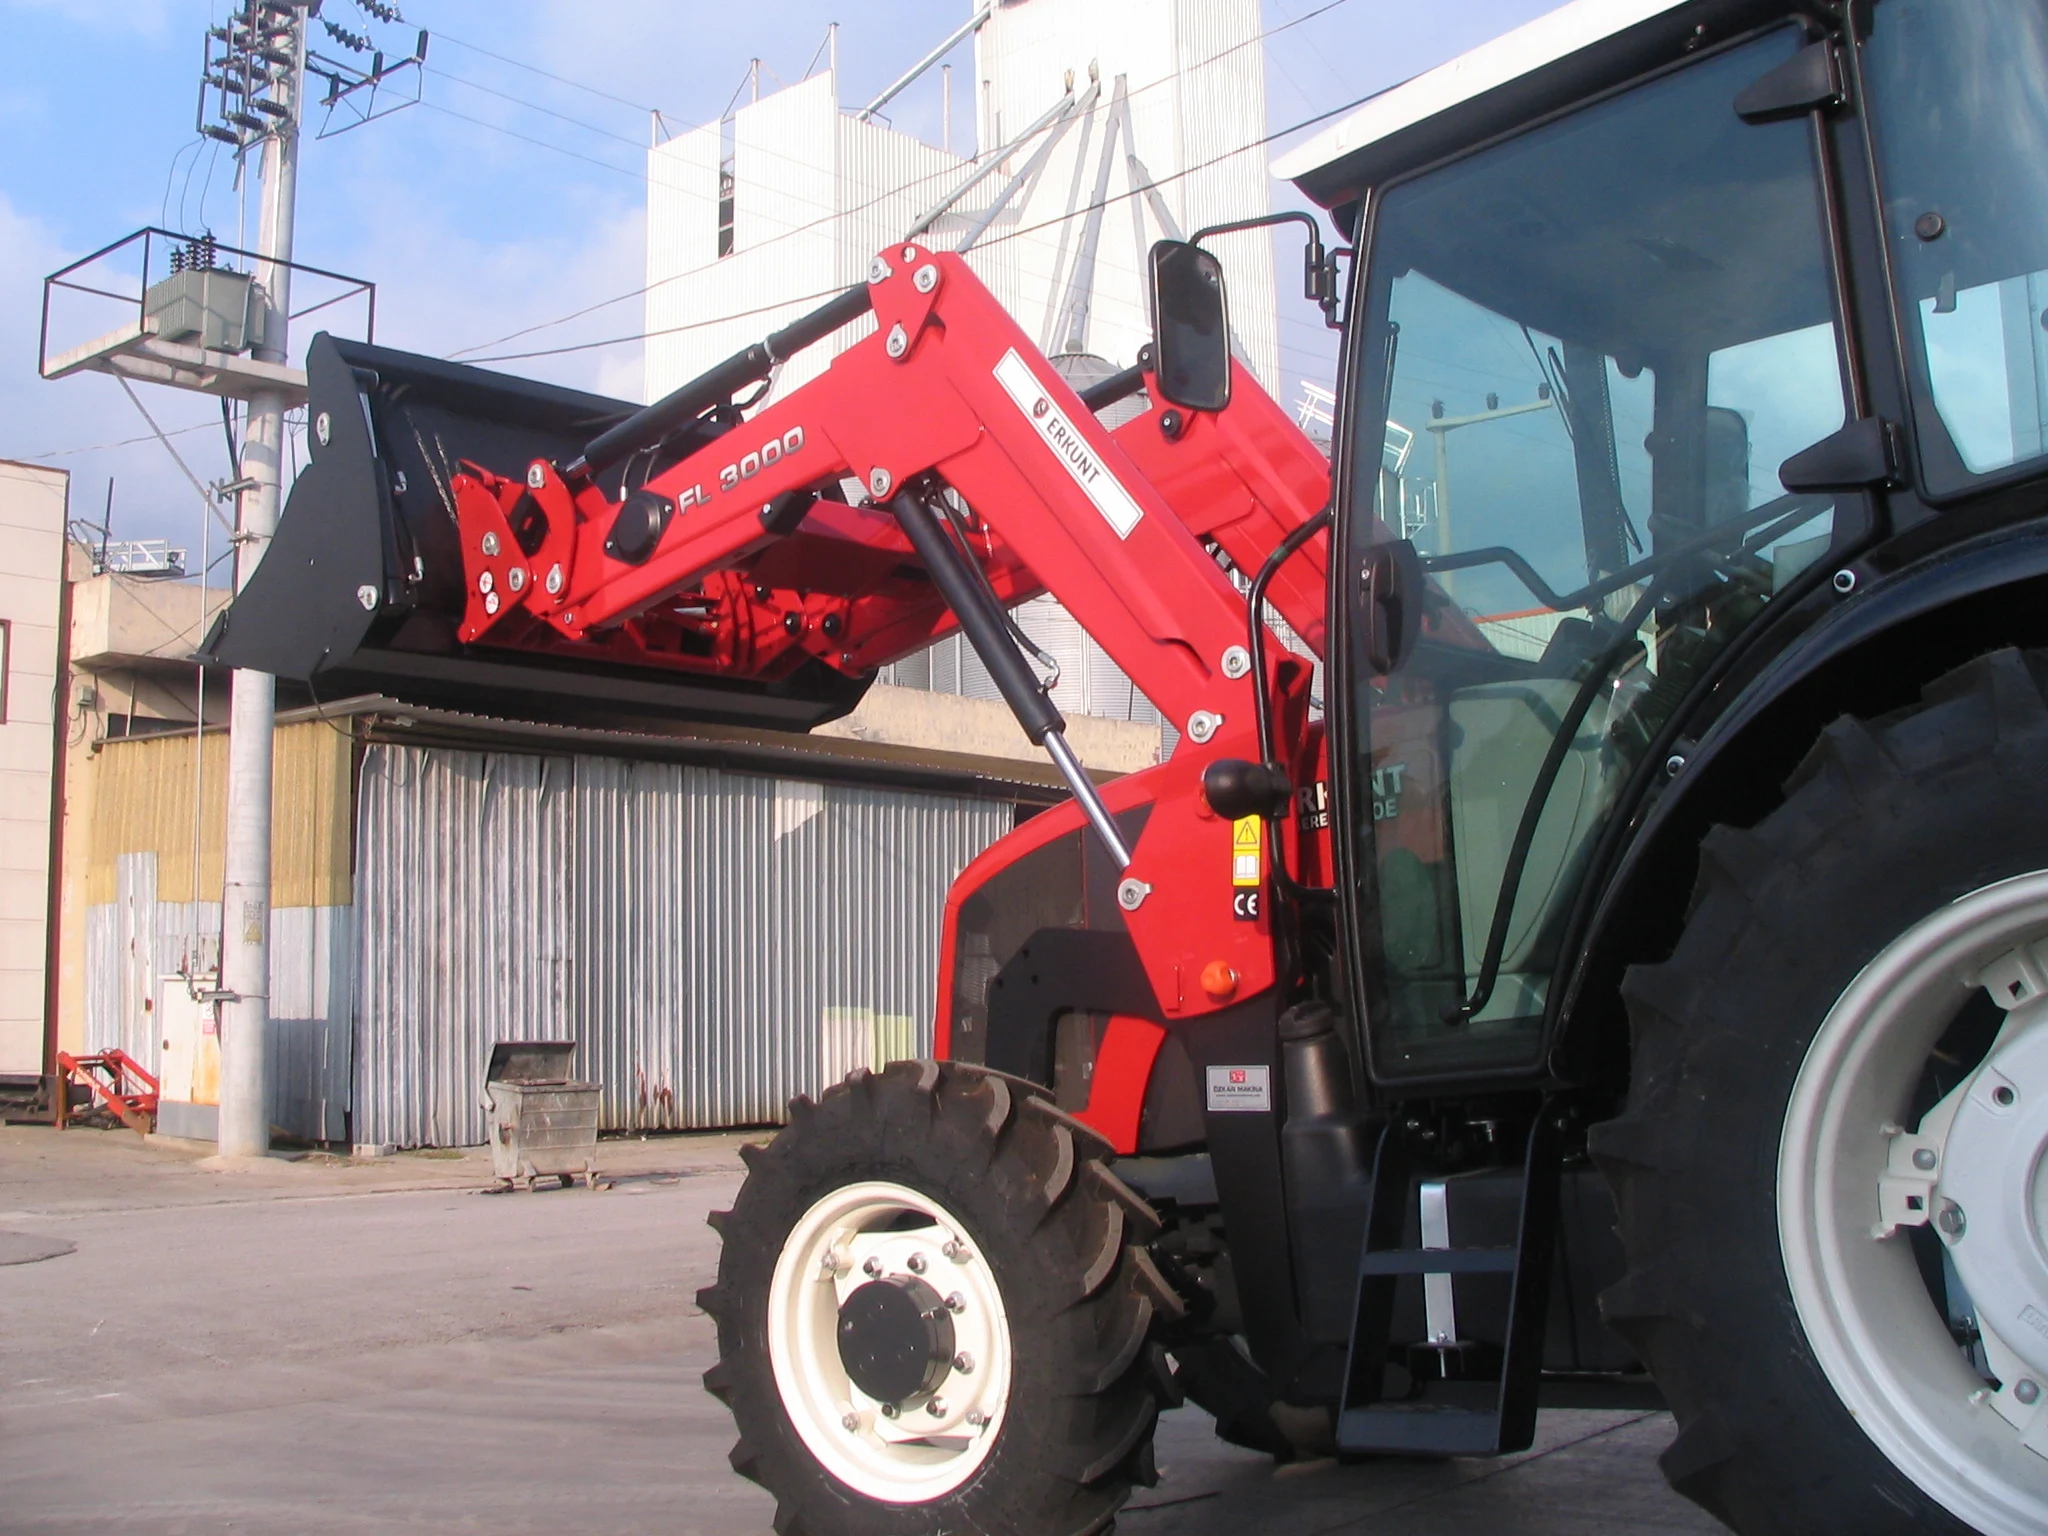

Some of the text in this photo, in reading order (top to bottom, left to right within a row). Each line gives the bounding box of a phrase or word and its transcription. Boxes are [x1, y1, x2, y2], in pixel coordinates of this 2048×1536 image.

[678, 425, 804, 515] FL 3000
[1046, 416, 1100, 483] ERKUNT
[1233, 893, 1258, 916] CE
